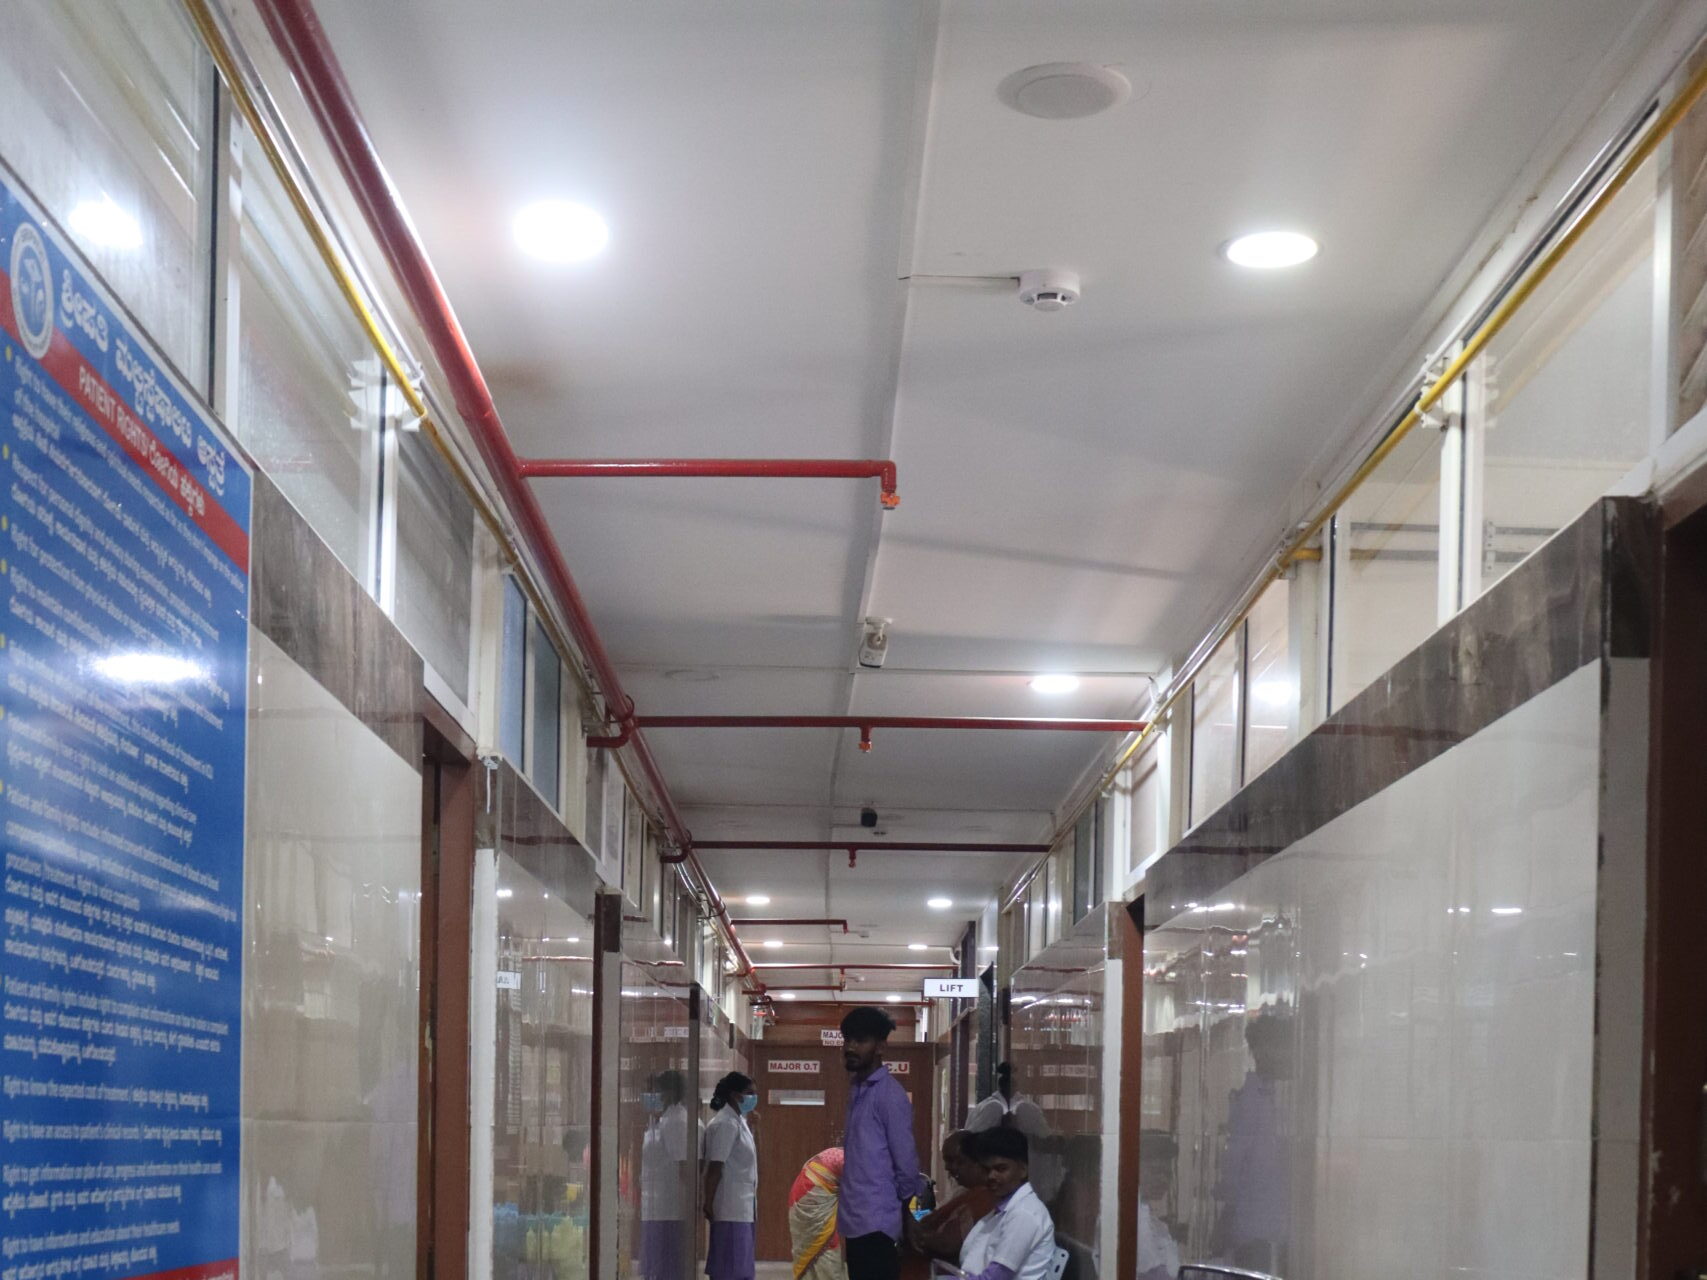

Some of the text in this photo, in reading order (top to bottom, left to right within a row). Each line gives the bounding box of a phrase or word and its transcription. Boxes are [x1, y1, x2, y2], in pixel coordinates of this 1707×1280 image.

[79, 366, 116, 422] PATIENT
[770, 1062, 818, 1071] MAJOR O.T
